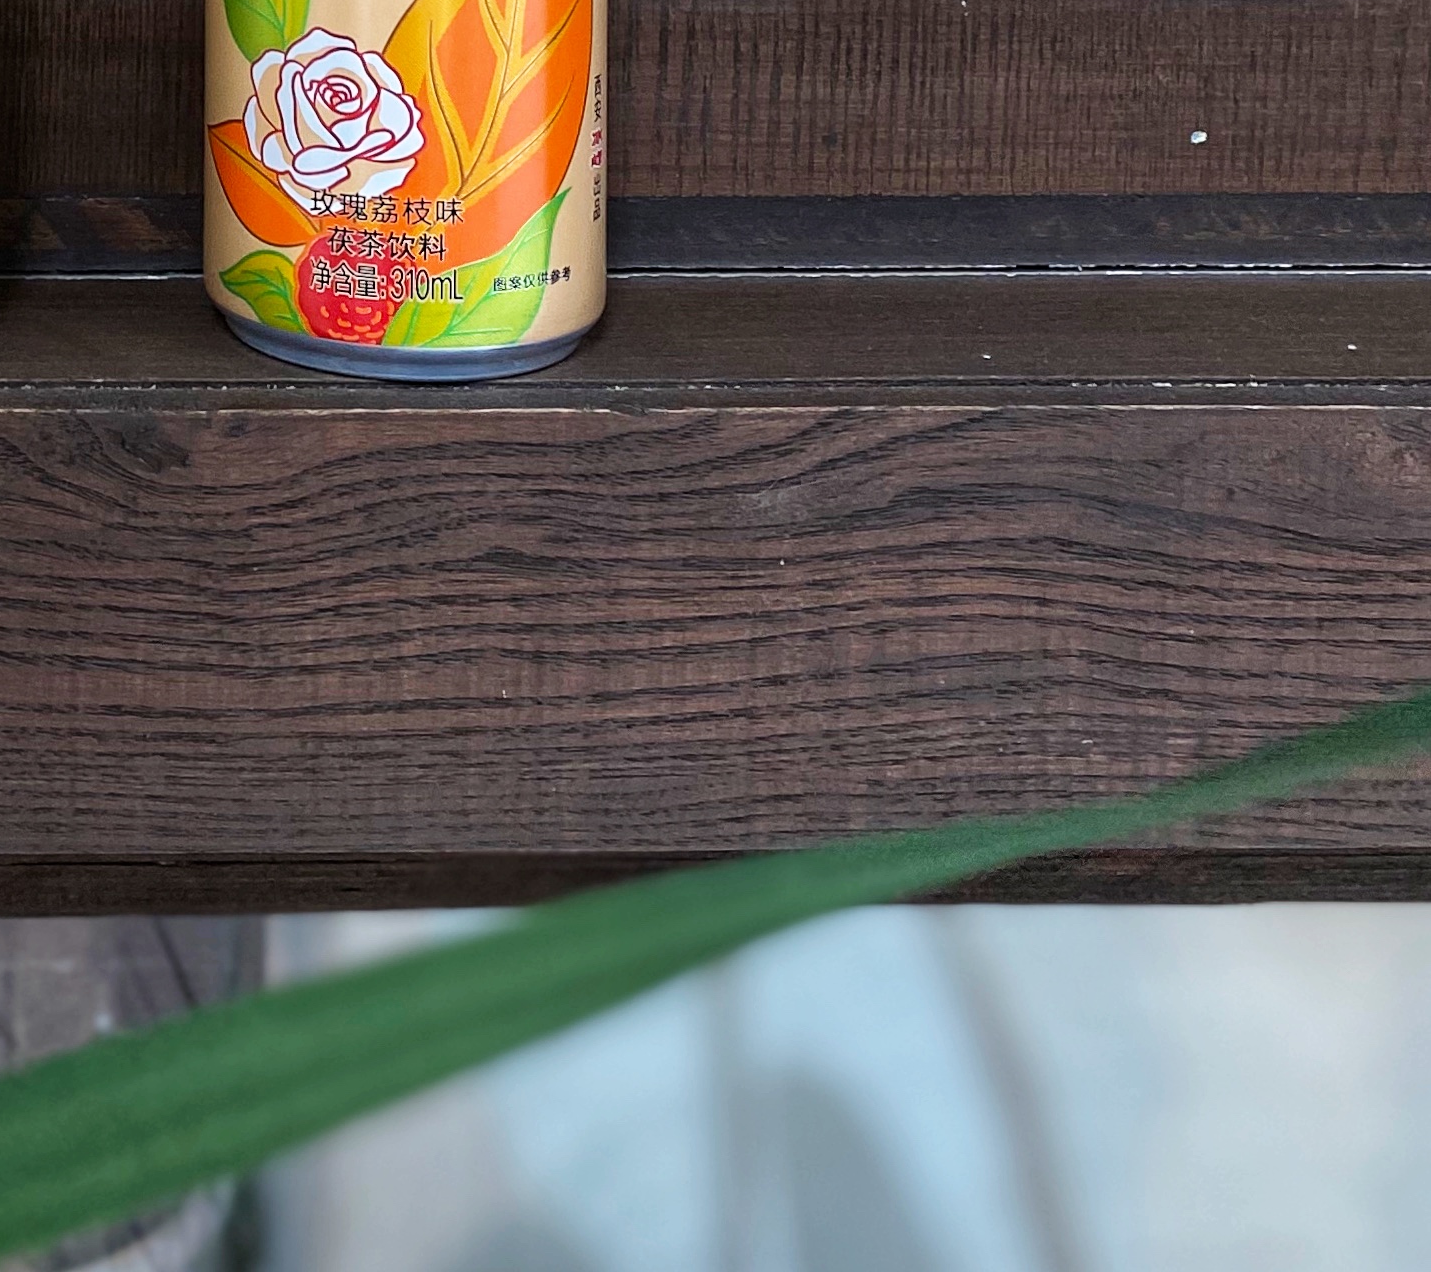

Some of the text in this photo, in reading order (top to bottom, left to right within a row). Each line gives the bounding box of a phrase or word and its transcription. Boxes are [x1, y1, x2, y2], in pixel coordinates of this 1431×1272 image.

[310, 189, 464, 226] 玫瑰荔枝味
[327, 225, 447, 261] 茯茶饮料
